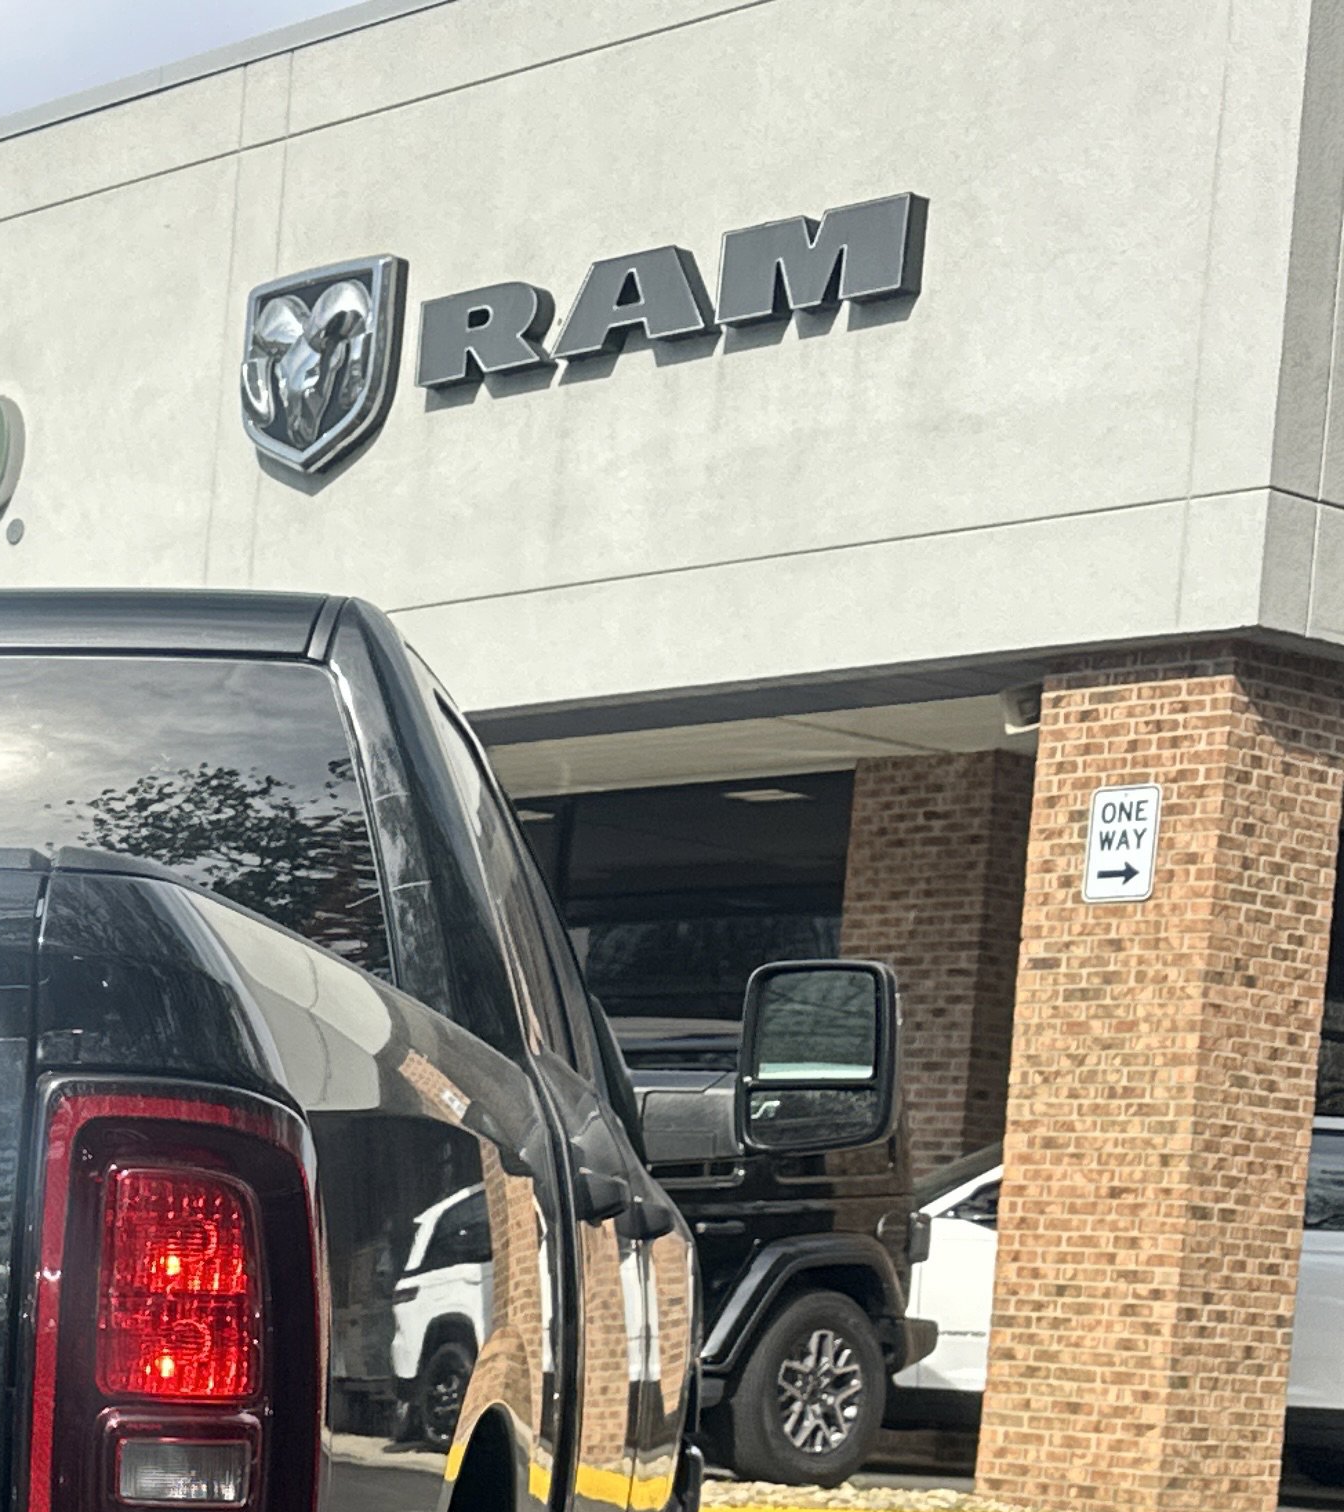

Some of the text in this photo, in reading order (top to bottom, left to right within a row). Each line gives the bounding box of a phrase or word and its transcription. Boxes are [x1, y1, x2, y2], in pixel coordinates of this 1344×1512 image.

[415, 192, 929, 390] RAM
[1101, 799, 1149, 824] ONE
[1099, 828, 1147, 852] WAY
